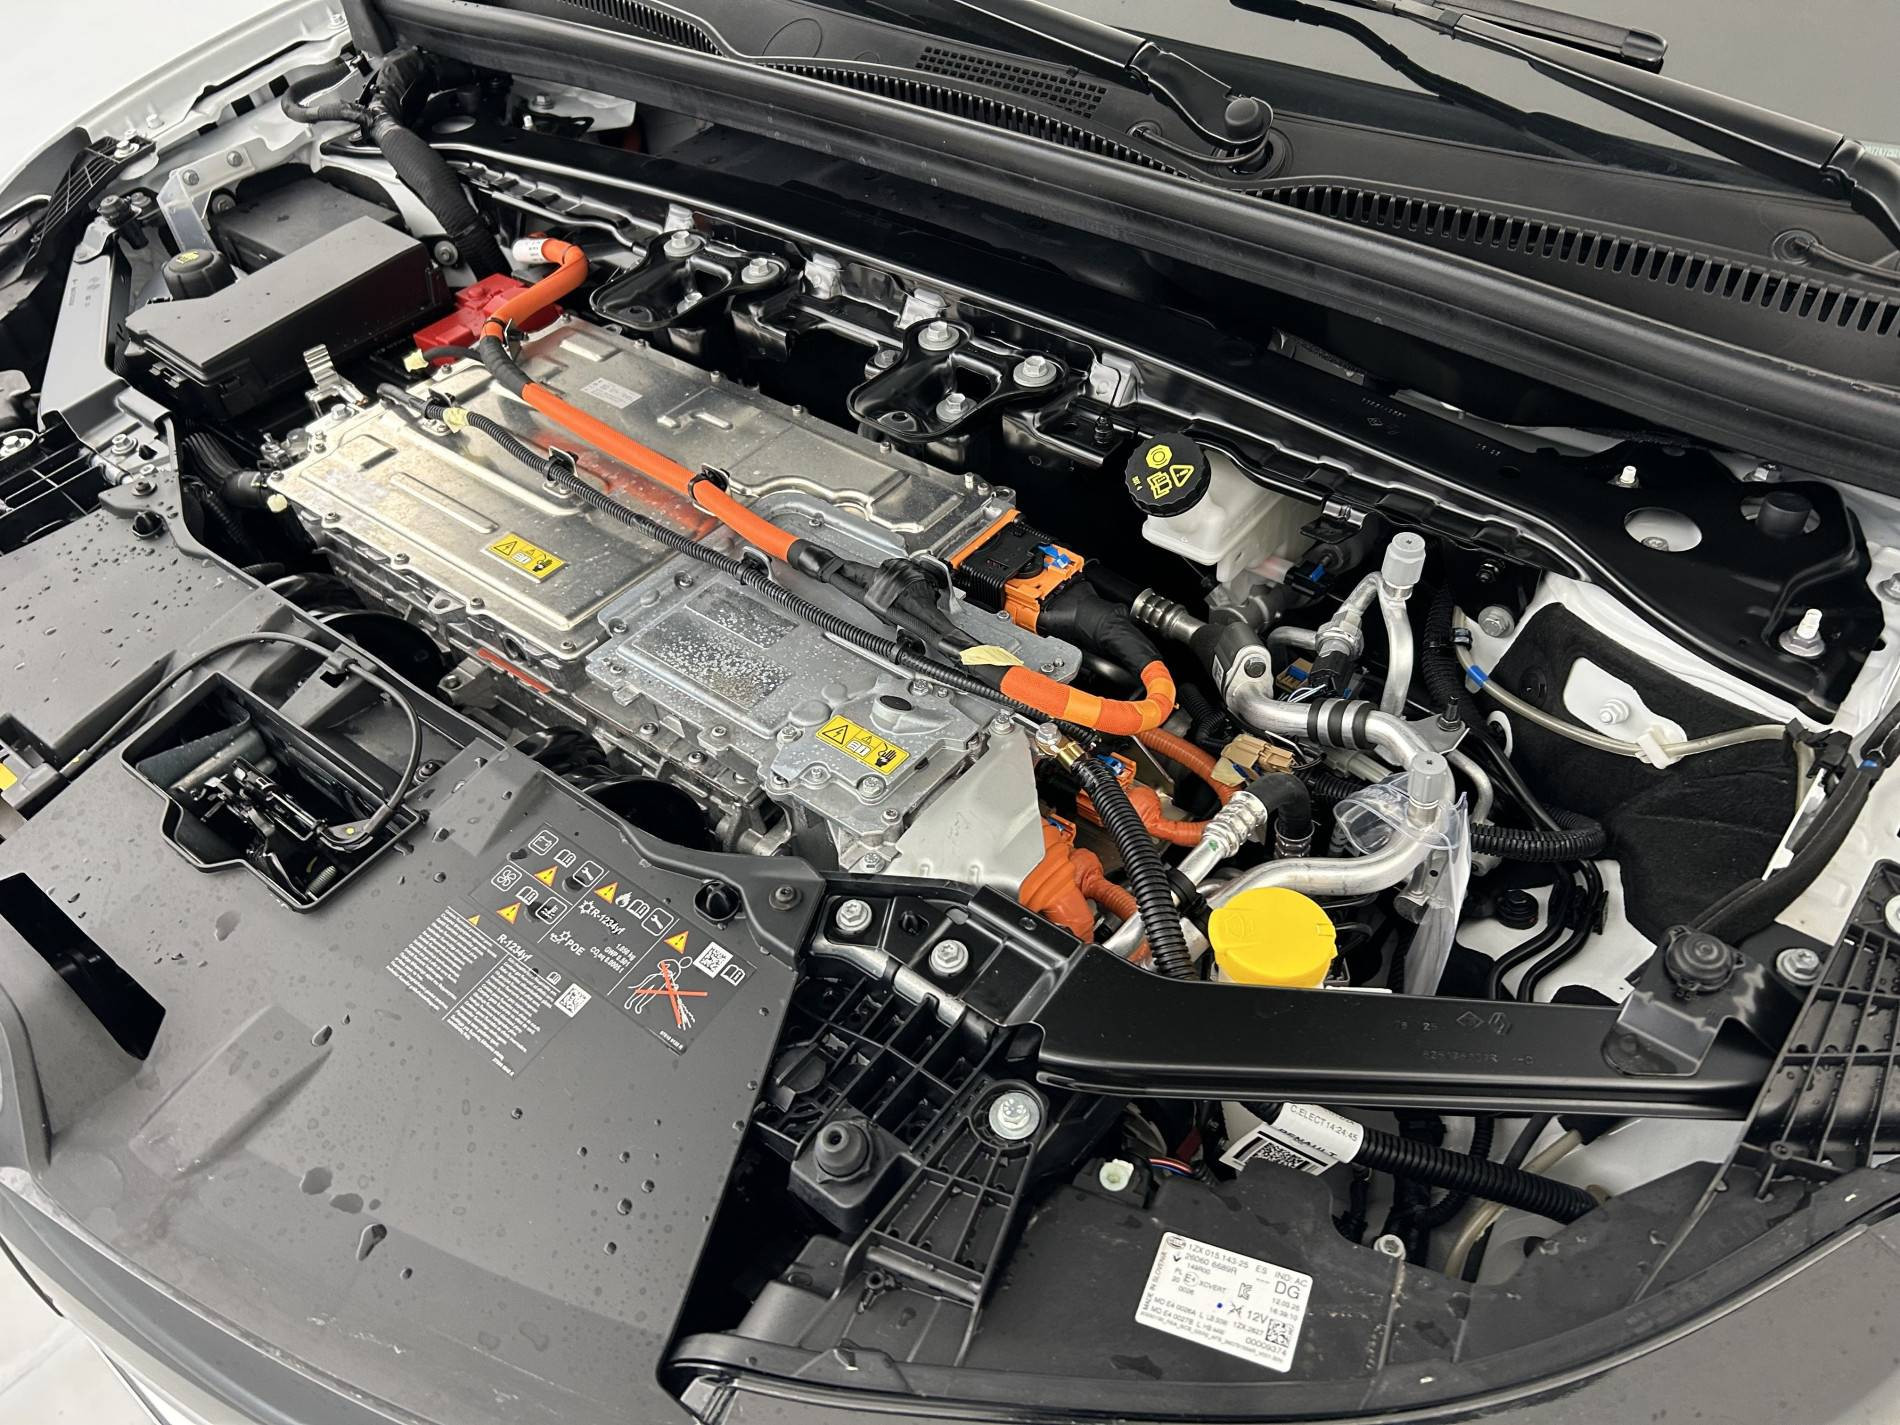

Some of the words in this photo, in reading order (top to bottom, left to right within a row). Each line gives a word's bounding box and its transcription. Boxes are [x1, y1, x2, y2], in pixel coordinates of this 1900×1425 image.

[590, 908, 626, 935] R-1234yf
[496, 934, 534, 962] R-1234yf
[564, 938, 586, 957] POE
[604, 946, 619, 957] GWP
[628, 952, 636, 961] kg
[1151, 1251, 1167, 1283] SLOVENIA
[1188, 1243, 1205, 1254] 1ZX
[1255, 1264, 1268, 1274] ES
[1294, 1276, 1308, 1288] AC
[1148, 1283, 1156, 1291] IN
[1273, 1279, 1301, 1300] DG
[1141, 1291, 1153, 1310] MADE
[1246, 1309, 1268, 1325] 12V
